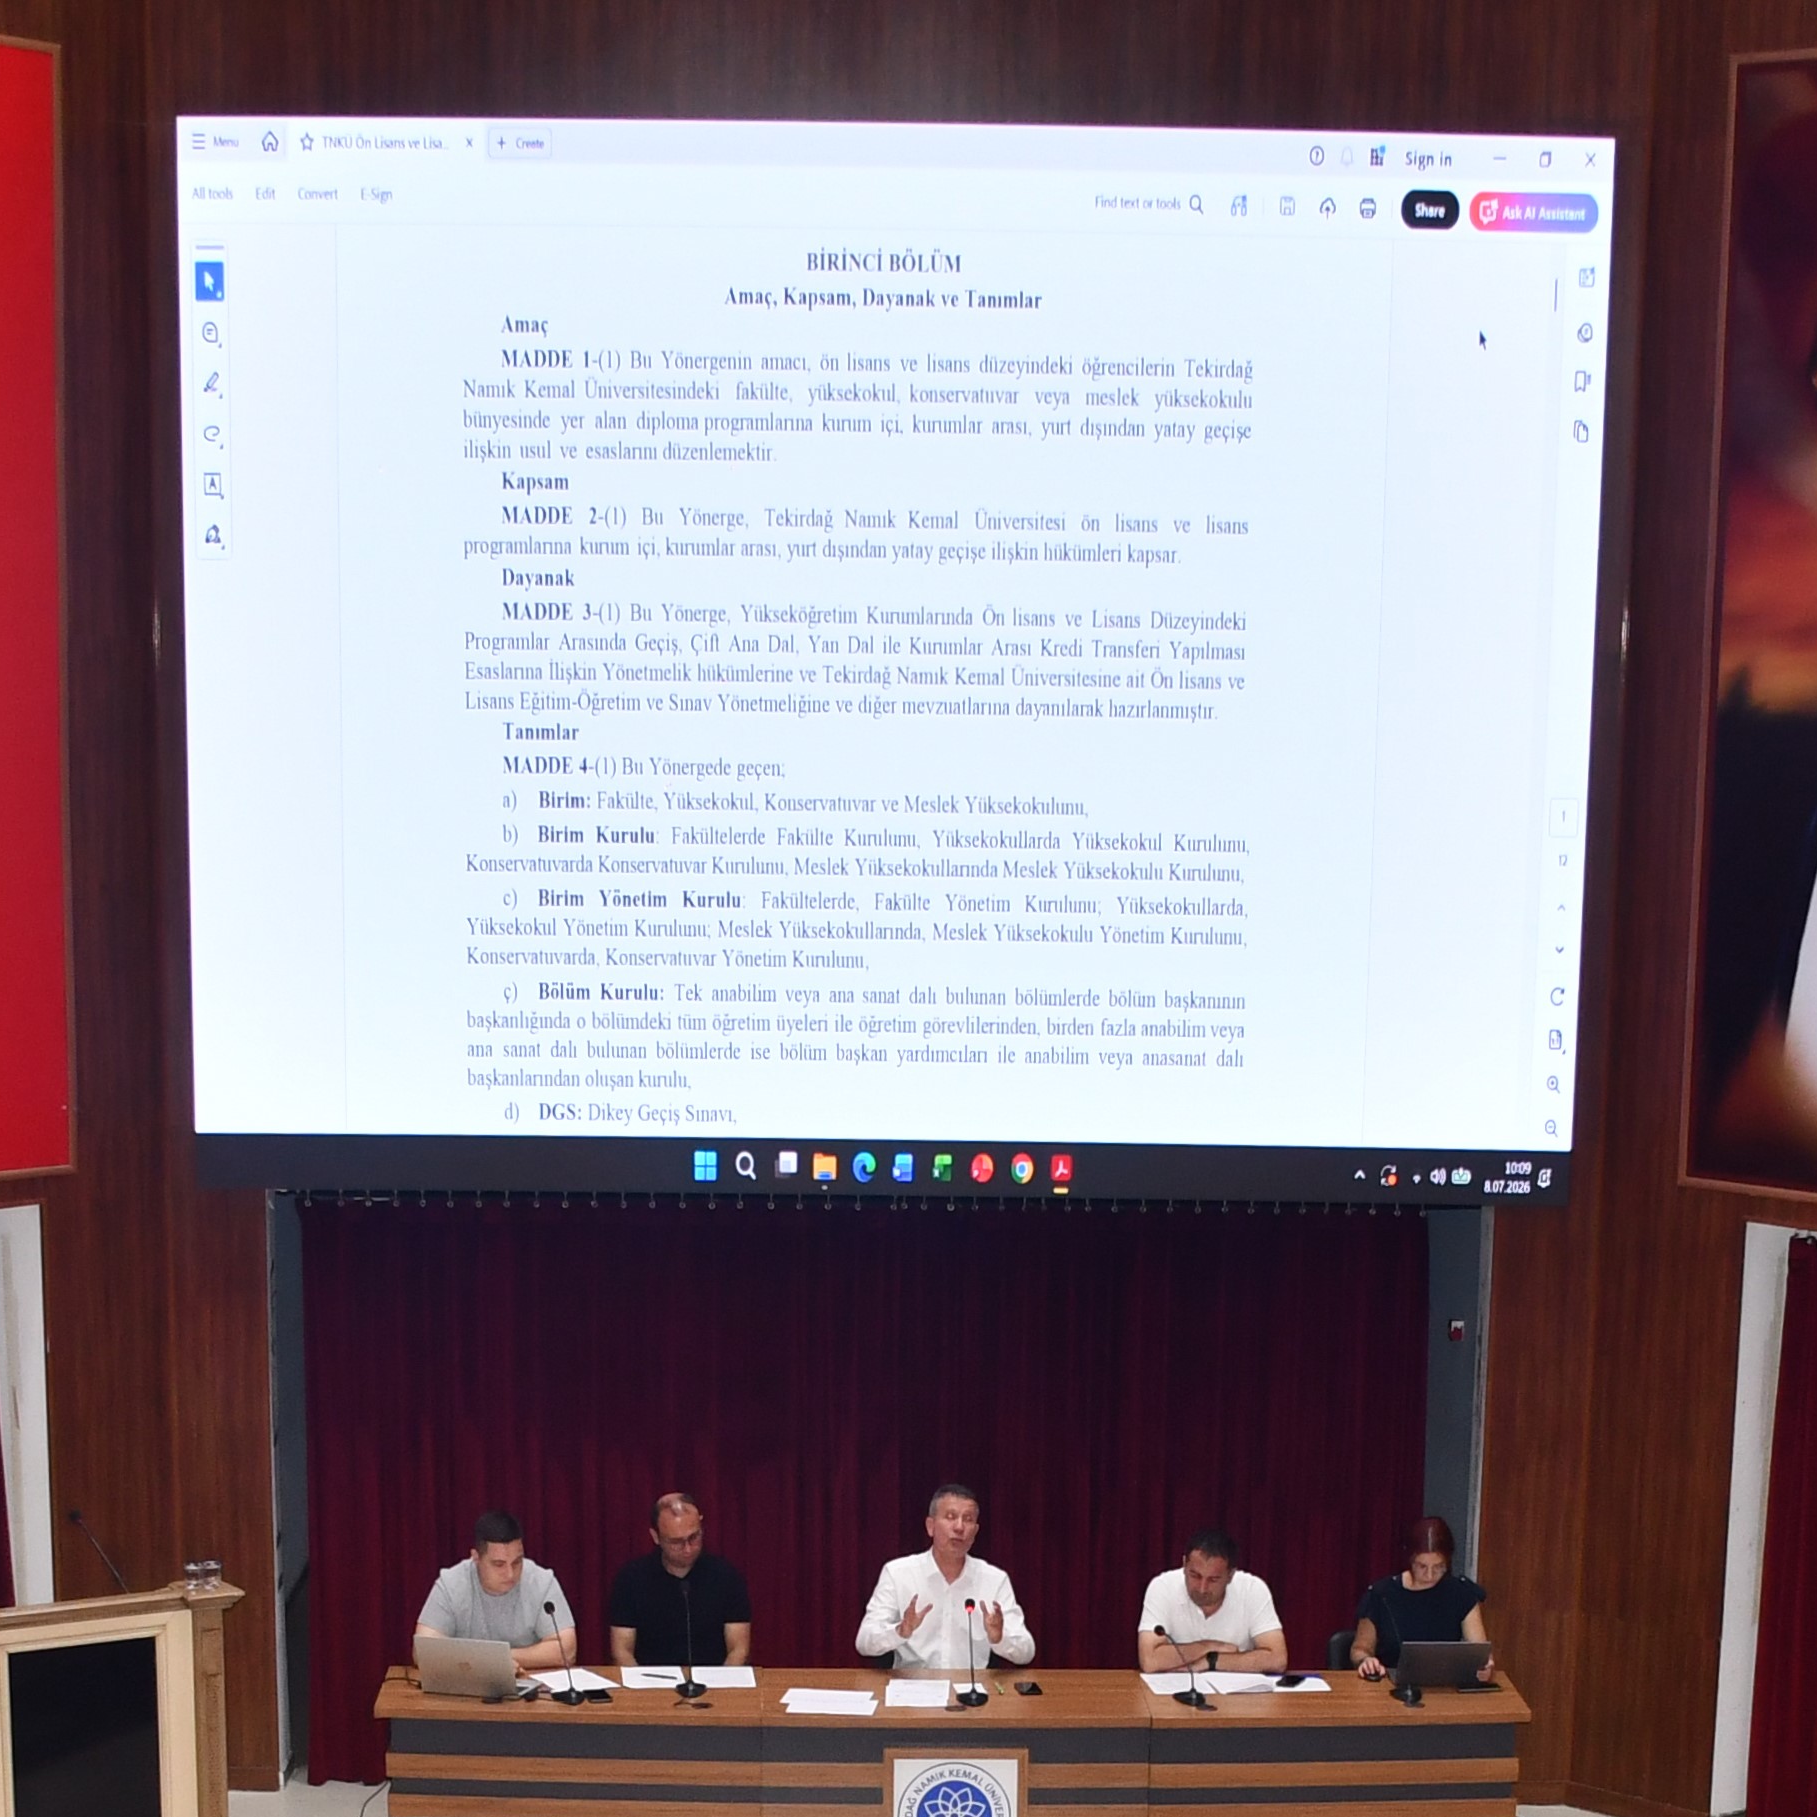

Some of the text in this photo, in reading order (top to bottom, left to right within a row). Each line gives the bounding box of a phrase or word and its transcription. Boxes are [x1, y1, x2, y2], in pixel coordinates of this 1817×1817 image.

[356, 134, 371, 149] Ön
[375, 136, 405, 149] Lisans
[408, 140, 420, 149] ve
[1406, 151, 1452, 170] Sign in
[192, 187, 233, 199] All tools
[256, 187, 275, 200] Edit
[298, 188, 338, 200] Convert
[1095, 195, 1181, 210] Find text or tools
[1415, 203, 1446, 219] Share
[1503, 206, 1522, 219] Ask
[1538, 206, 1586, 221] Assistant
[806, 247, 961, 273] BİRİNCİ BÖLÜM
[724, 287, 1043, 312] Amaç, Kapsam, Dayanak ve Tanımlar
[500, 315, 549, 338] Amaç
[501, 349, 574, 368] MADDE
[630, 350, 652, 369] Bu
[661, 350, 753, 376] Yönergenin
[760, 356, 811, 372] amacı,
[819, 354, 840, 371] ön
[847, 352, 891, 372] lisans
[900, 359, 918, 372] ve
[927, 353, 971, 373] lisans
[978, 354, 1073, 380] düzeyindeki
[1081, 356, 1175, 382] öğrencilerin
[1183, 358, 1253, 384] Tekirdağ
[463, 377, 1253, 414] Namık Kemal Üniversitesindeki fakülte, yüksekokul, konservatuvar veya meslek yüksekokulu
[462, 409, 1252, 444] bünyesinde yer alan diploma programlarına kurum içi, kurumlar arası, yurt dışından yatay geçişe
[463, 440, 512, 463] ilişkin
[519, 439, 552, 459] usul
[559, 446, 578, 459] ve
[585, 440, 658, 460] esaslarını
[501, 471, 570, 496] Kapsam
[501, 505, 574, 525] MADDE
[641, 507, 664, 525] Bu
[678, 507, 749, 532] Yönerge,
[763, 507, 834, 533] Tekirdağ
[844, 508, 896, 528] Namık
[908, 510, 959, 529] Kemal
[974, 508, 1066, 531] Üniversitesi
[1080, 515, 1100, 531] ön
[1115, 512, 1159, 533] lisans
[1173, 520, 1191, 533] ve
[1206, 515, 1249, 534] lisans
[502, 567, 575, 592] Dayanak
[502, 601, 574, 621] MADDE
[630, 603, 653, 621] Bu
[661, 603, 731, 628] Yönerge,
[740, 603, 858, 629] Yükseköğretim
[866, 606, 973, 626] Kurumlarında
[982, 604, 1005, 626] Ön
[1012, 607, 1056, 627] lisans
[1064, 614, 1083, 627] ve
[1092, 609, 1141, 629] Lisans
[1150, 610, 1247, 636] Düzeyindeki
[502, 722, 580, 741] Tanımlar
[502, 755, 574, 774] MADDE
[622, 757, 644, 775] Bu
[648, 756, 732, 782] Yönergede
[736, 763, 786, 783] geçen;
[502, 790, 518, 811] a)
[538, 791, 591, 809] Birim:
[597, 790, 659, 811] Fakülte,
[663, 791, 759, 812] Yüksekokul,
[764, 793, 877, 813] Konservatuvar
[881, 800, 899, 812] ve
[904, 794, 960, 814] Meslek
[502, 824, 1250, 856] b) Birim Kurulu: Fakültelerde Fakülte Kurulunu, Yüksekokullarda Yüksekokul Kurulunu,
[605, 947, 718, 967] Konservatuvar
[721, 949, 787, 968] Yönetim
[792, 950, 870, 971] Kurulunu,
[467, 1068, 692, 1092] başkanlarından oluşan kurulu,
[504, 1101, 737, 1126] d) DGS: Dikey Geçiş Sınavı,
[1505, 1161, 1532, 1175] 10:09
[1484, 1180, 1530, 1193] 8.07.2026
[913, 1769, 946, 1795] NAMIK
[948, 1768, 984, 1786] KEMAL
